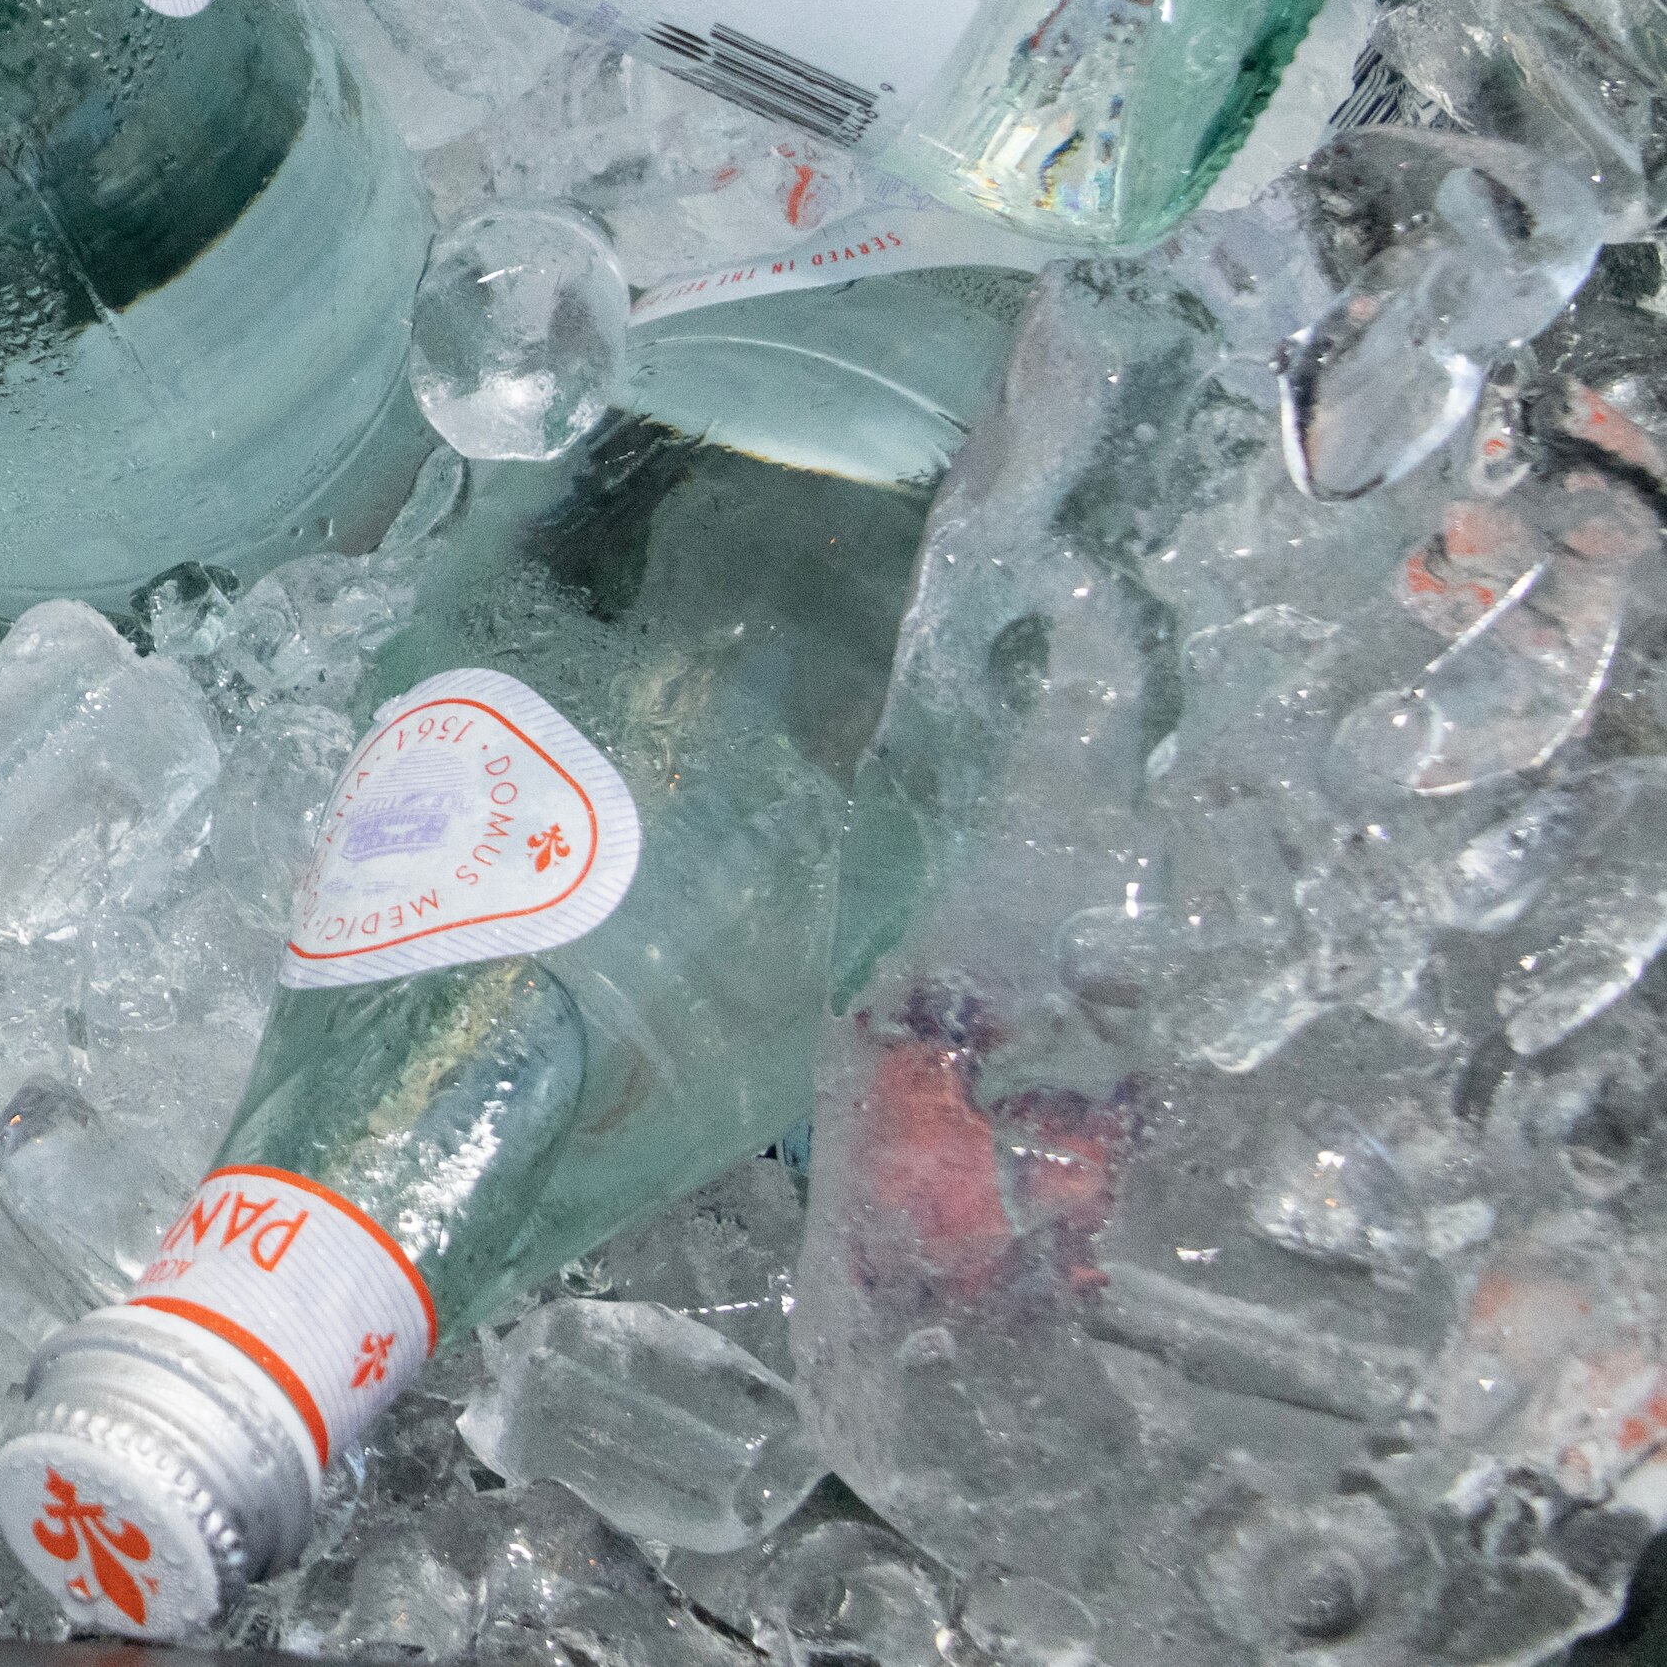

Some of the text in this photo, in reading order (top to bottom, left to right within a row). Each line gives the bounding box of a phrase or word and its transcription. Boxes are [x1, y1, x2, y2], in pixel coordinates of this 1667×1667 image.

[812, 231, 903, 266] SERVED
[772, 259, 795, 275] IN
[397, 715, 475, 751] 1564
[455, 755, 519, 885] DOMUS
[160, 1191, 310, 1273] PAN
